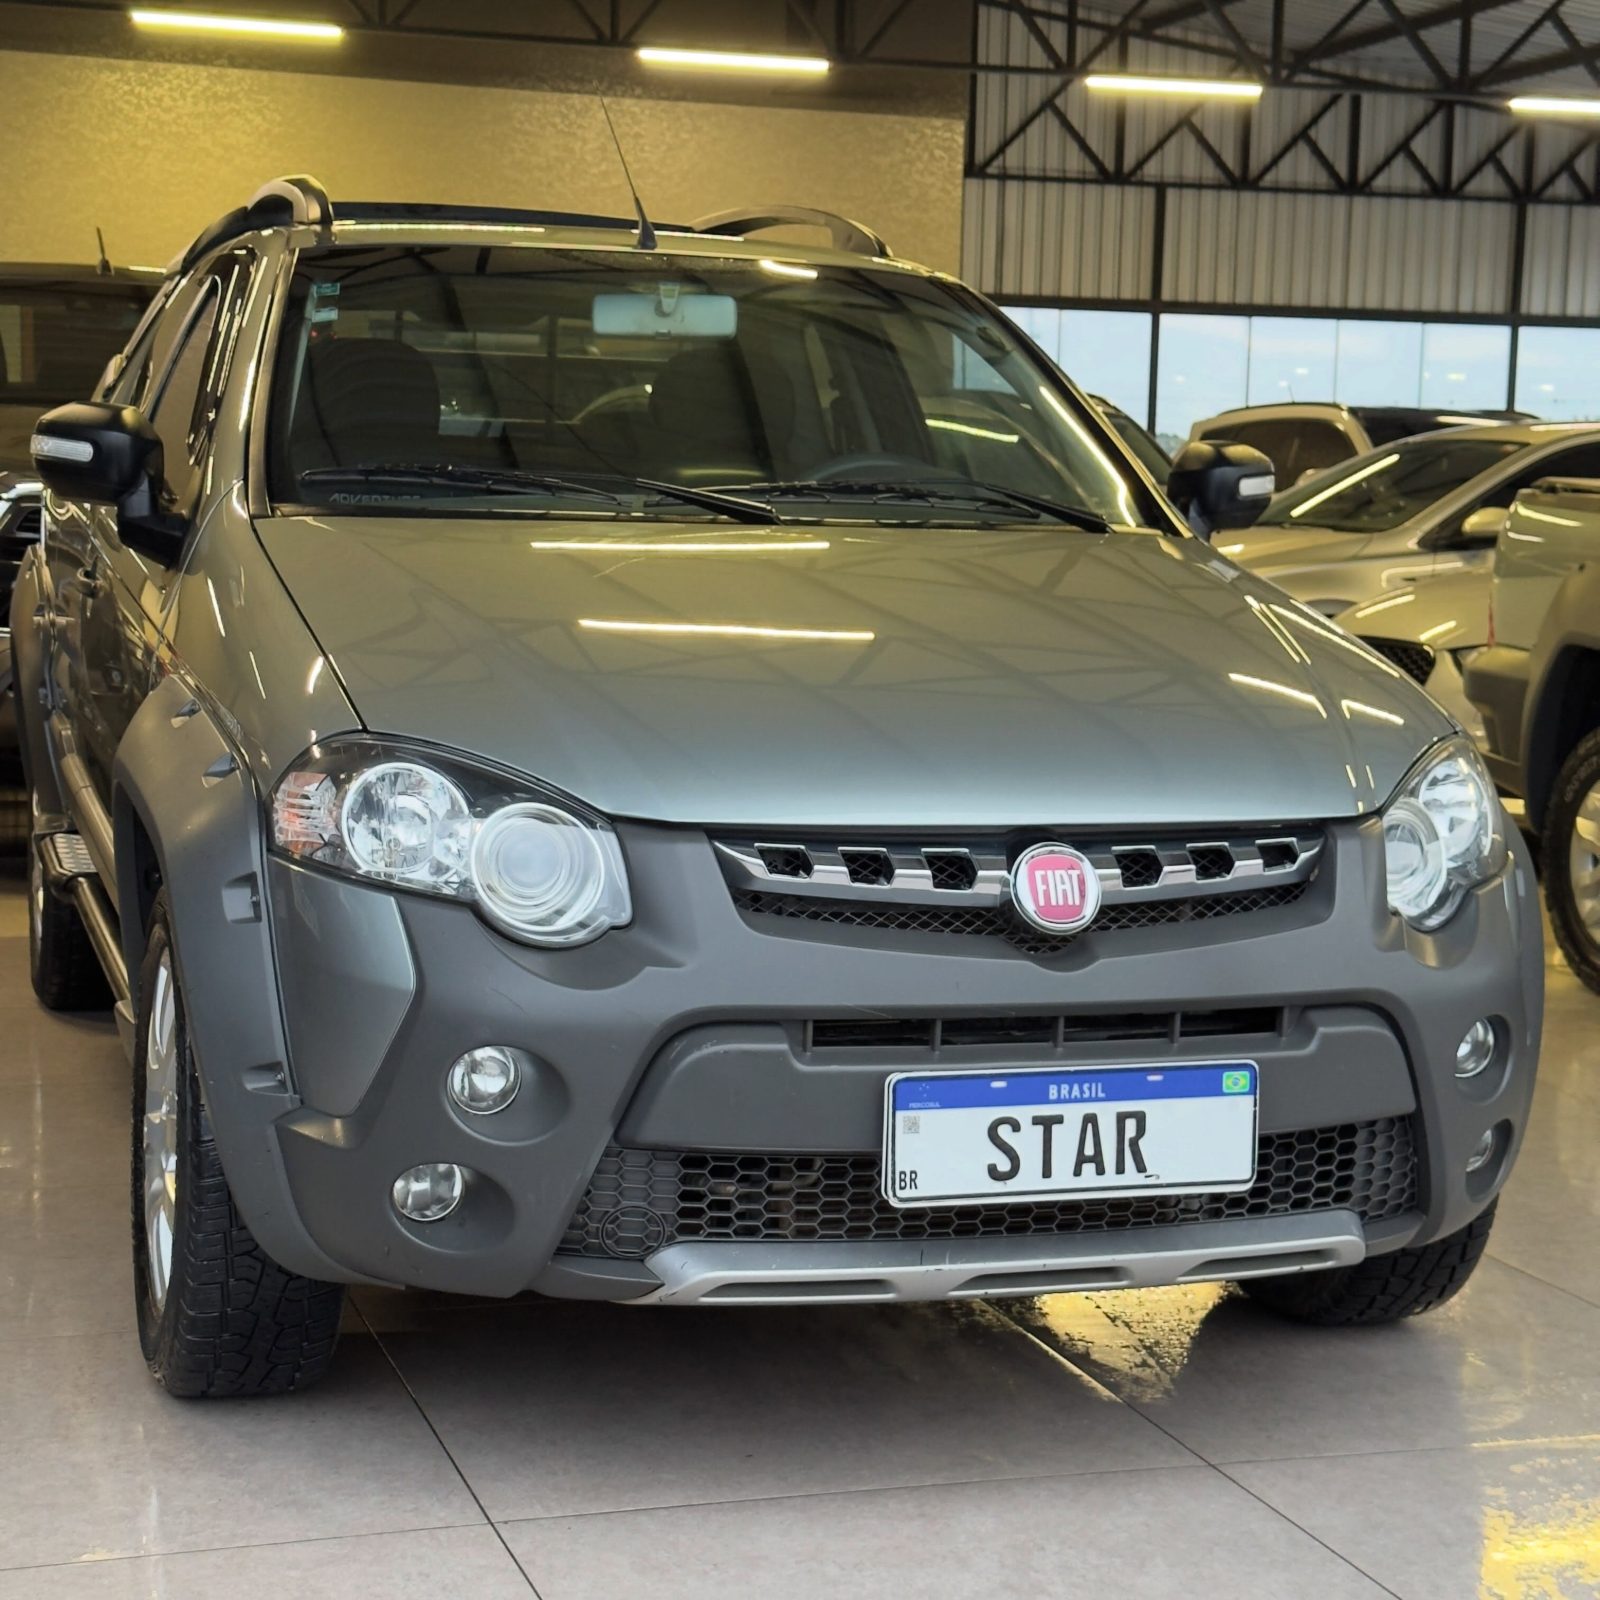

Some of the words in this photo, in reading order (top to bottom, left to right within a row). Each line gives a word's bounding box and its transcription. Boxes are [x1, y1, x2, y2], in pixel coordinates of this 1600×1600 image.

[1034, 870, 1081, 907] FIAT
[1048, 1082, 1106, 1100] BRASIL
[987, 1110, 1148, 1182] STAR
[898, 1169, 919, 1191] BR
